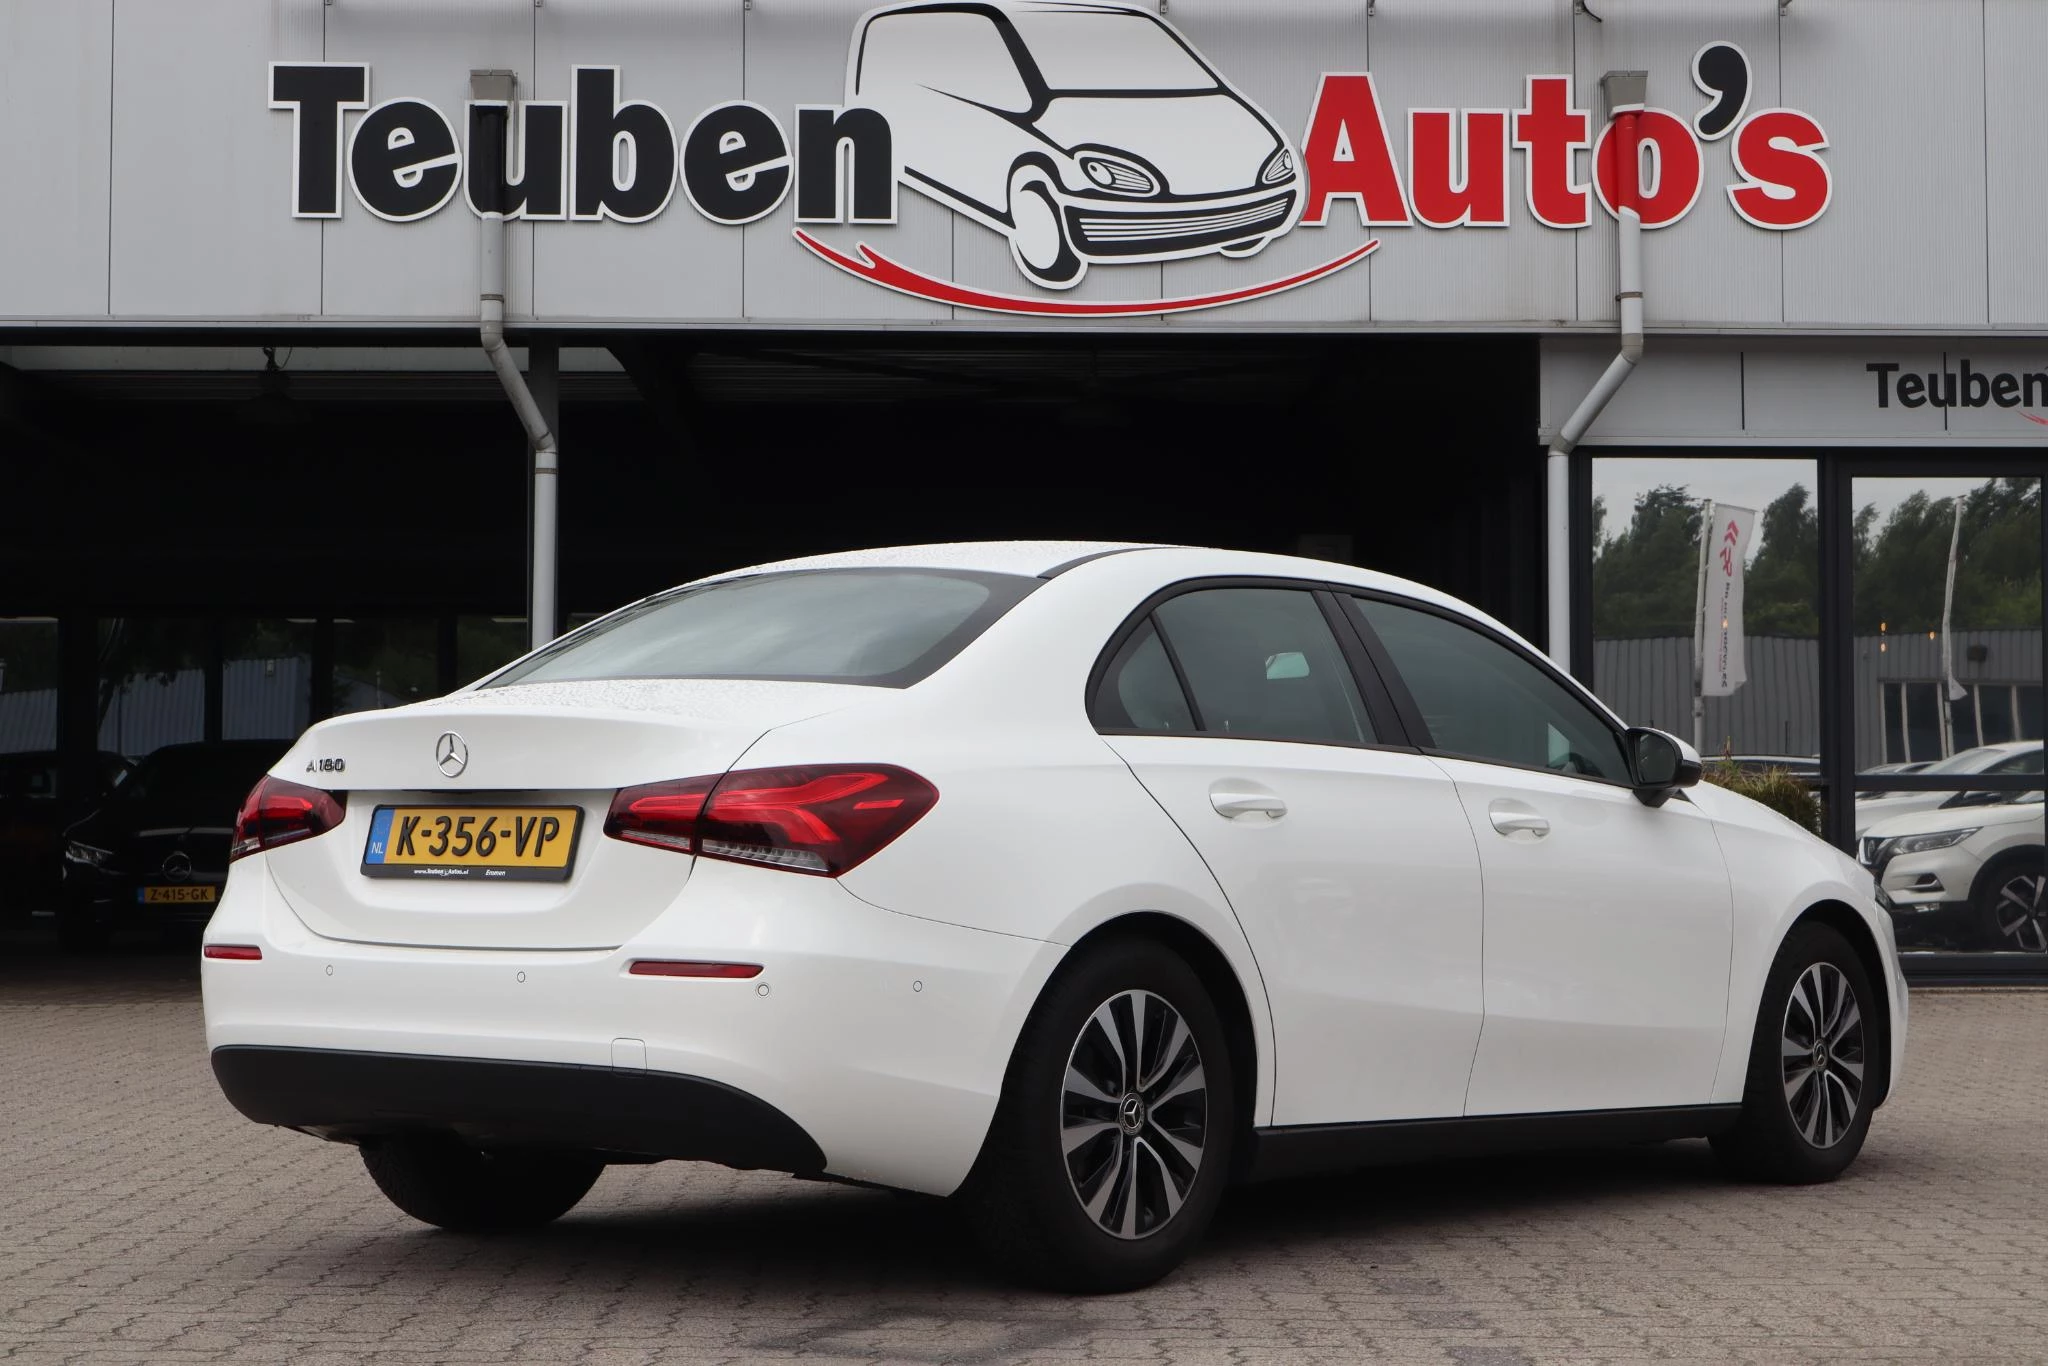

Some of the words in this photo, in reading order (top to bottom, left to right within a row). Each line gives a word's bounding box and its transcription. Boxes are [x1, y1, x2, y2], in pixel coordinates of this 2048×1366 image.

[271, 64, 895, 221] Teuben
[1301, 44, 1831, 229] Auto's
[1866, 359, 2048, 408] Teuben
[371, 842, 384, 854] NL
[396, 815, 560, 858] K-356-VP
[150, 888, 209, 901] Z-415-GK
